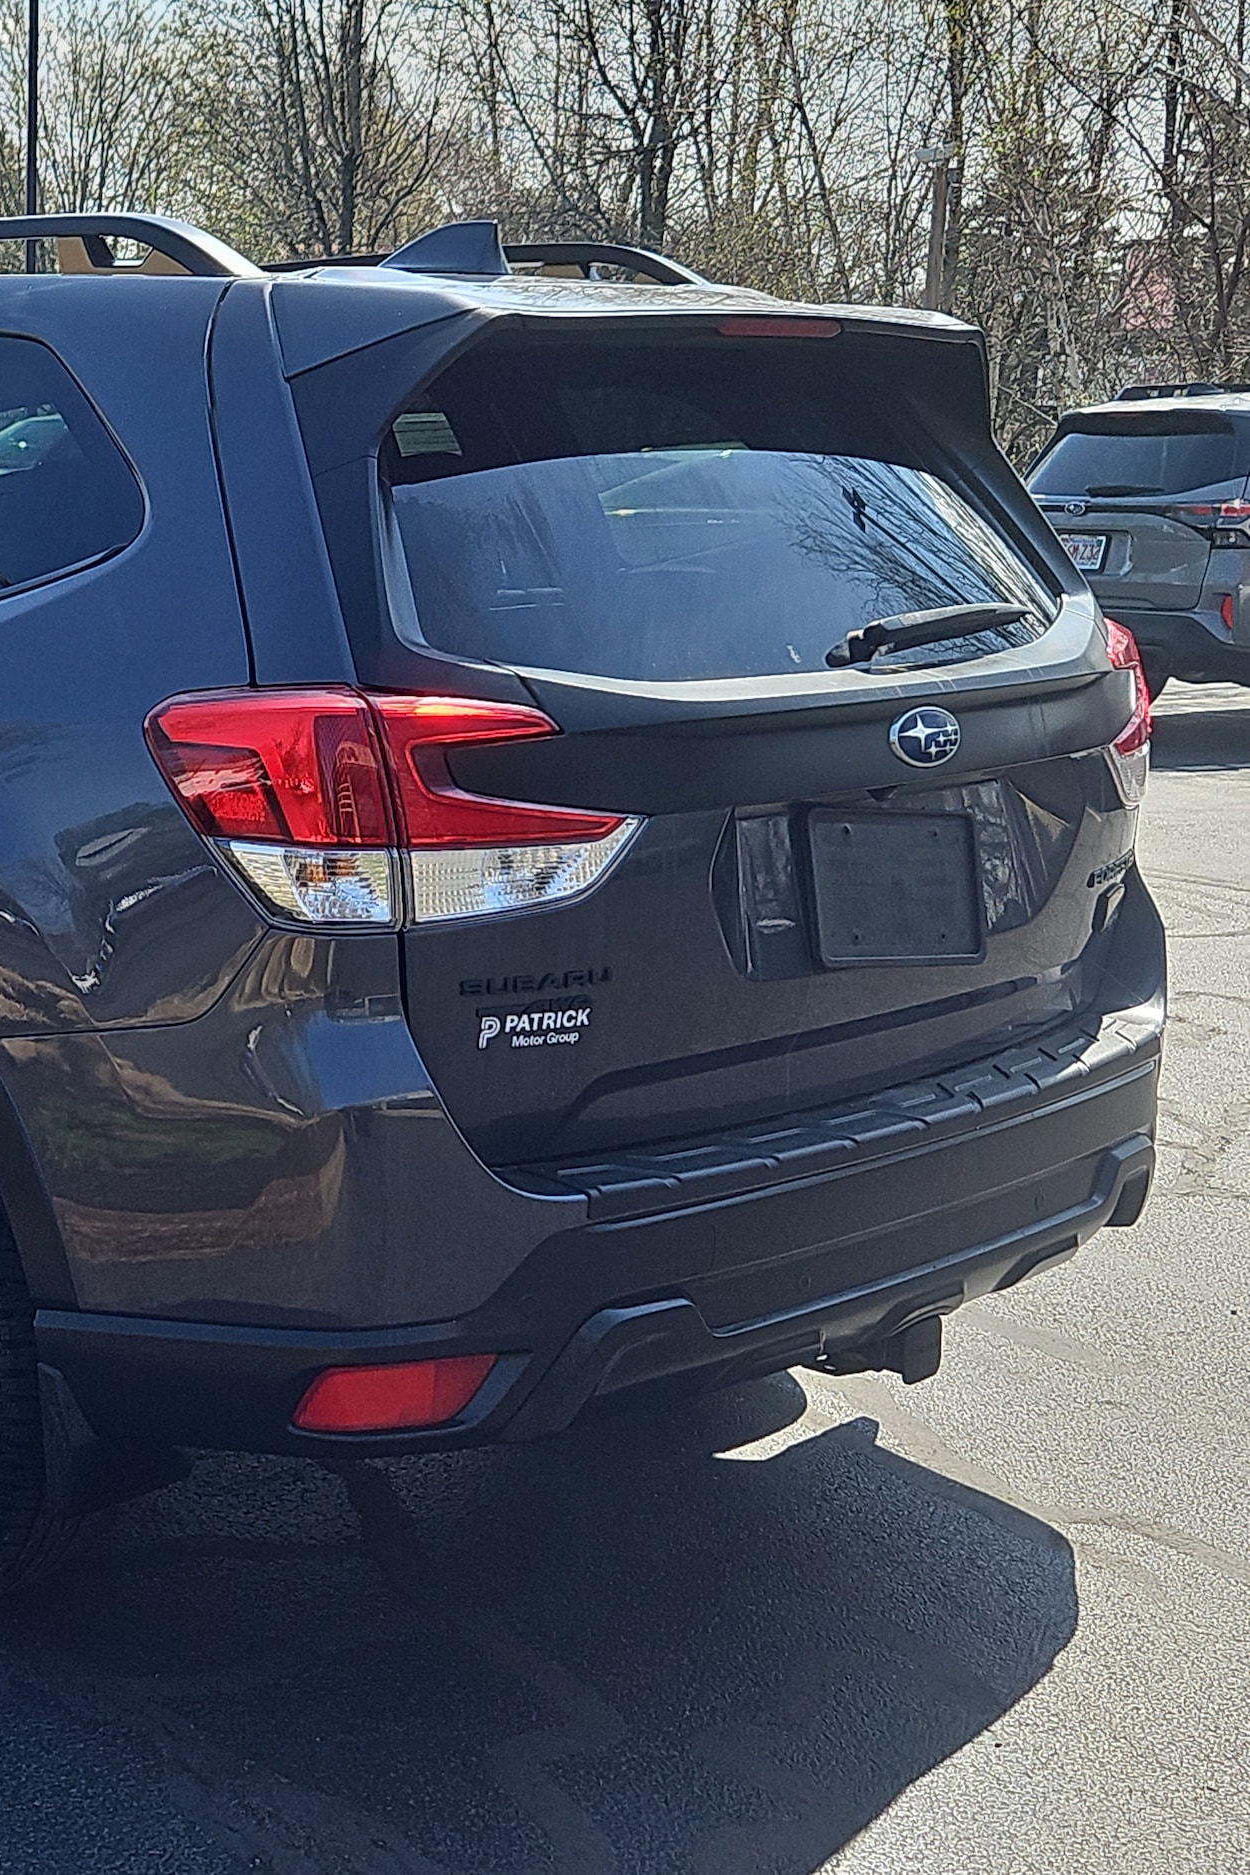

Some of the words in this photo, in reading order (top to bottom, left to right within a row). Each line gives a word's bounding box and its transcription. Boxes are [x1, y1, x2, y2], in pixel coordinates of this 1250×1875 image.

[459, 966, 613, 996] SUBARU
[504, 1007, 592, 1033] PATRICK
[511, 1034, 545, 1048] Motor
[546, 1031, 580, 1045] Group
